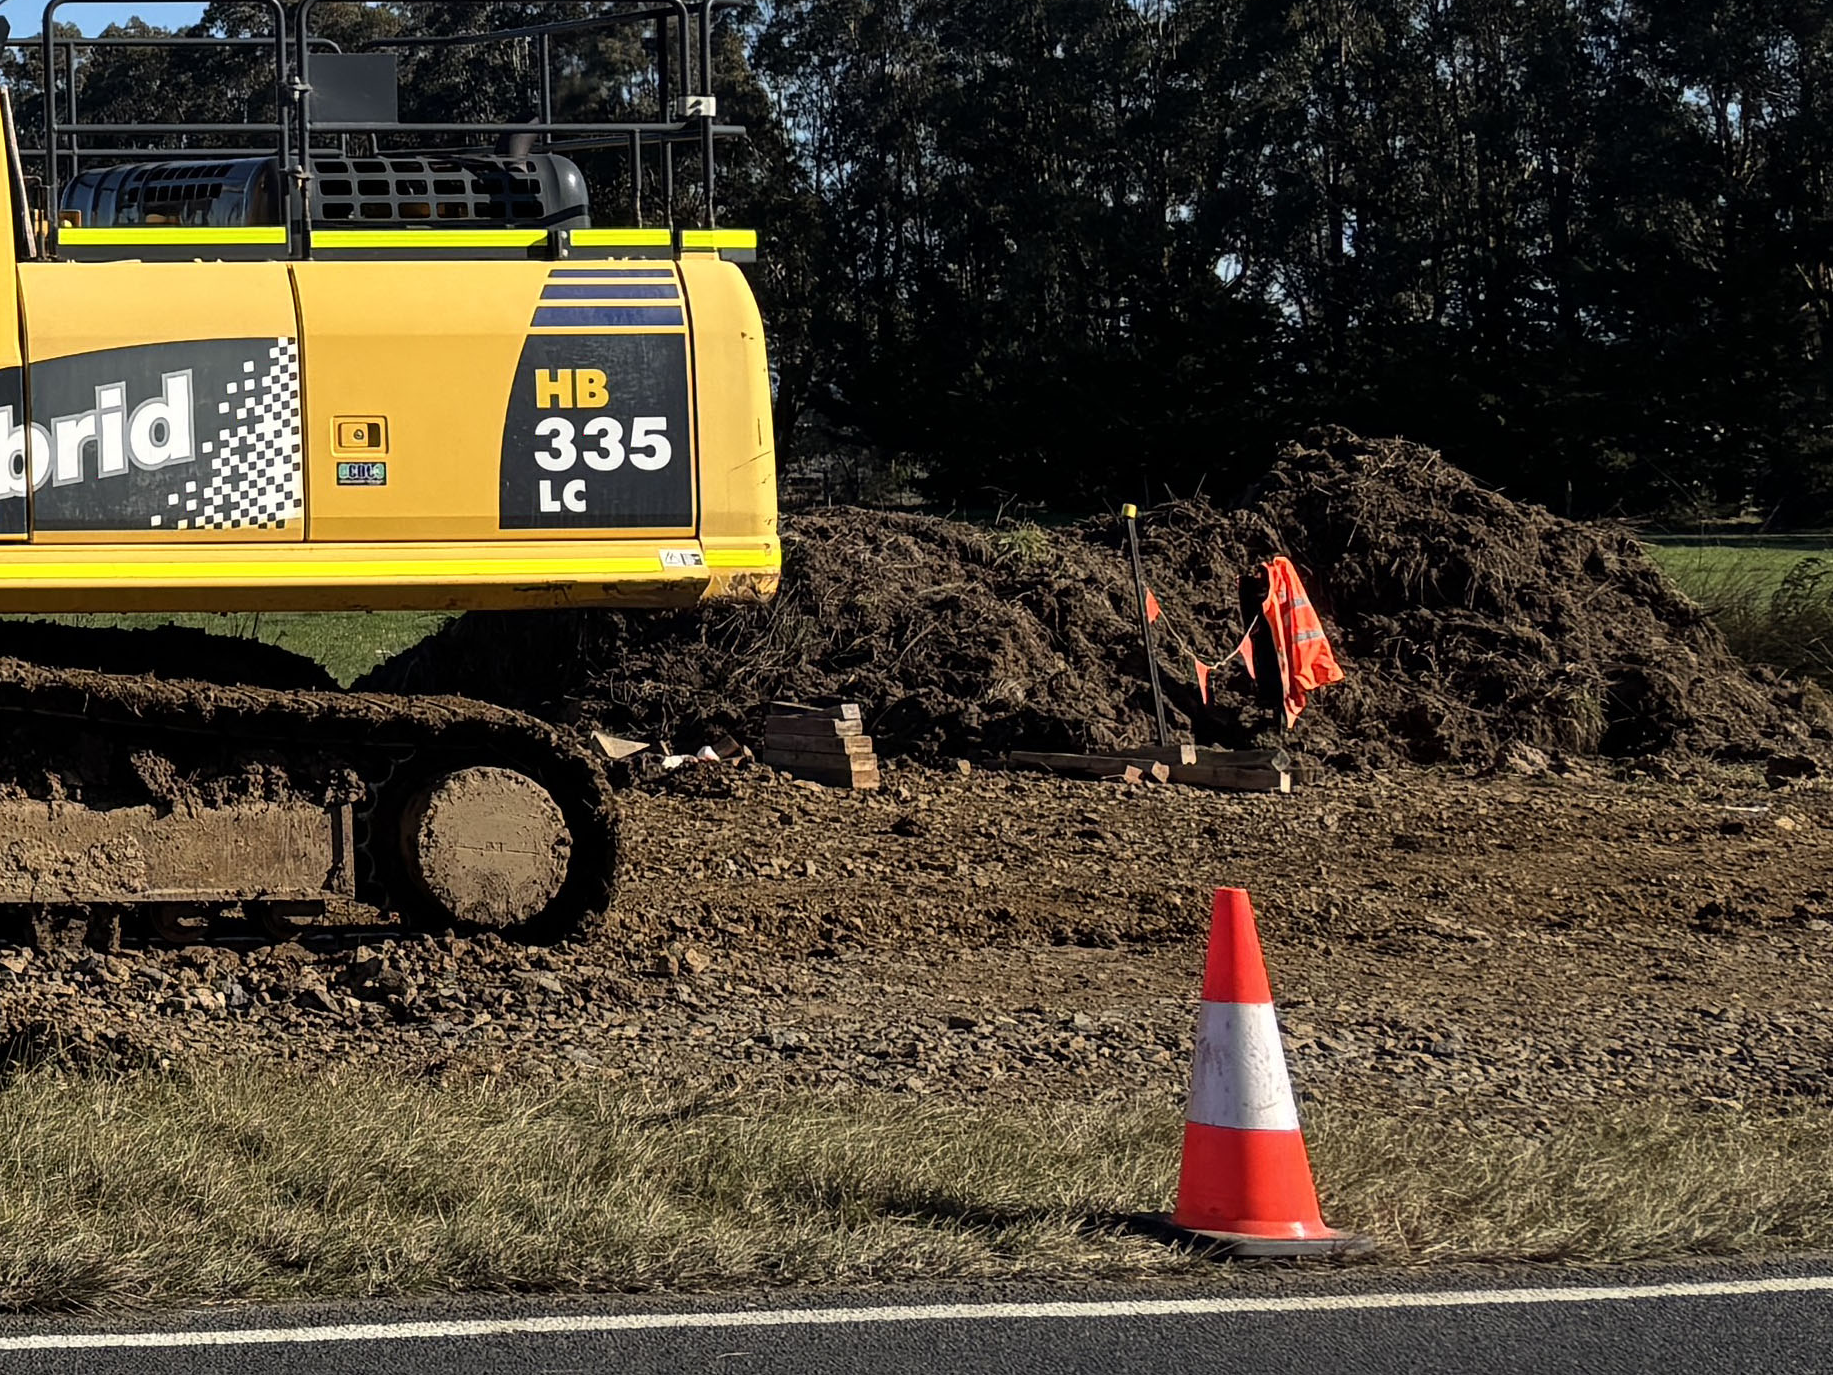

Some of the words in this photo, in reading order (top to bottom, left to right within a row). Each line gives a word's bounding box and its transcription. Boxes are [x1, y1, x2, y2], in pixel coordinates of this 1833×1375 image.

[534, 368, 610, 409] HB
[533, 416, 673, 472] 335
[538, 479, 588, 513] LC
